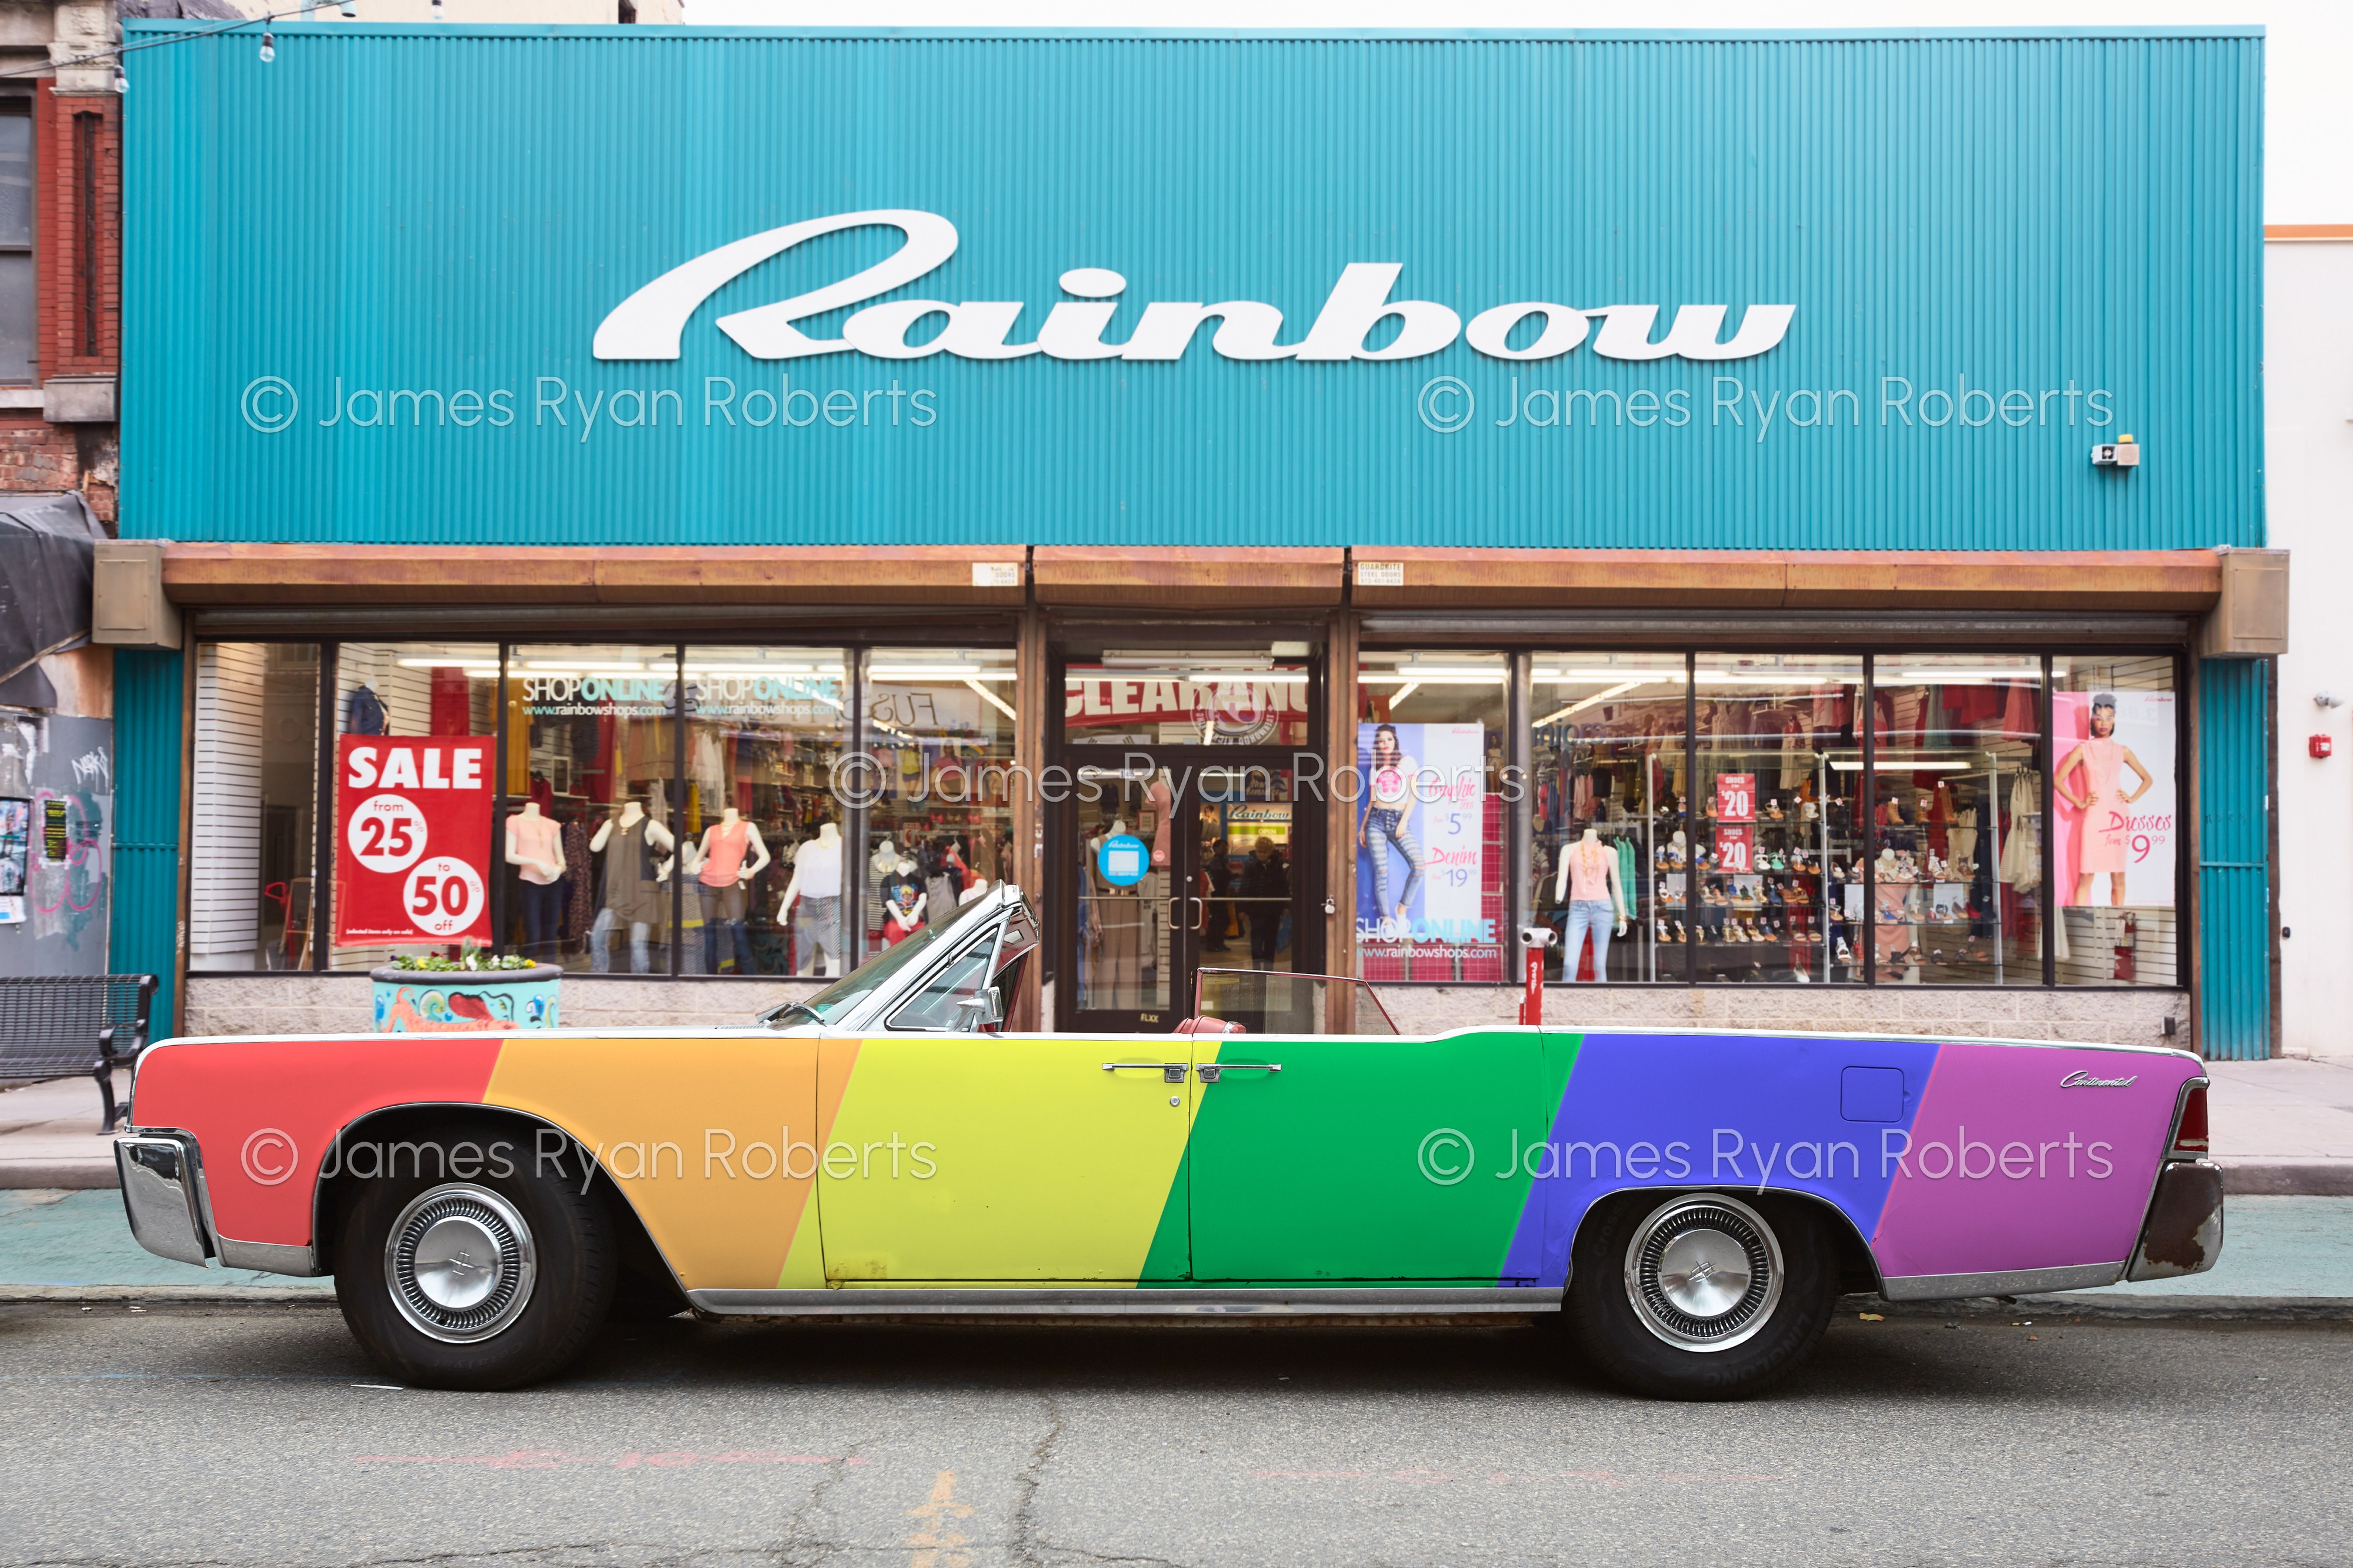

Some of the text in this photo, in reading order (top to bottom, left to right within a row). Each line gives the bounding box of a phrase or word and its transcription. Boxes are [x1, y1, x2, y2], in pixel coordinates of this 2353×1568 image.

[593, 209, 1795, 361] Rainbow
[522, 702, 666, 716] www.rainbowshops.com
[695, 701, 839, 716] www.rainbowshops.com
[348, 746, 482, 789] SALE
[373, 800, 404, 812] from
[1229, 799, 1289, 819] Rainbow
[1721, 790, 1749, 816] $20
[2098, 810, 2172, 833] Dresses
[1423, 845, 1478, 867] Denim
[1719, 842, 1747, 868] $20
[438, 862, 451, 872] to
[434, 920, 454, 931] off
[1357, 945, 1497, 962] www.rainbowshops.com
[2060, 1070, 2138, 1088] Continental
